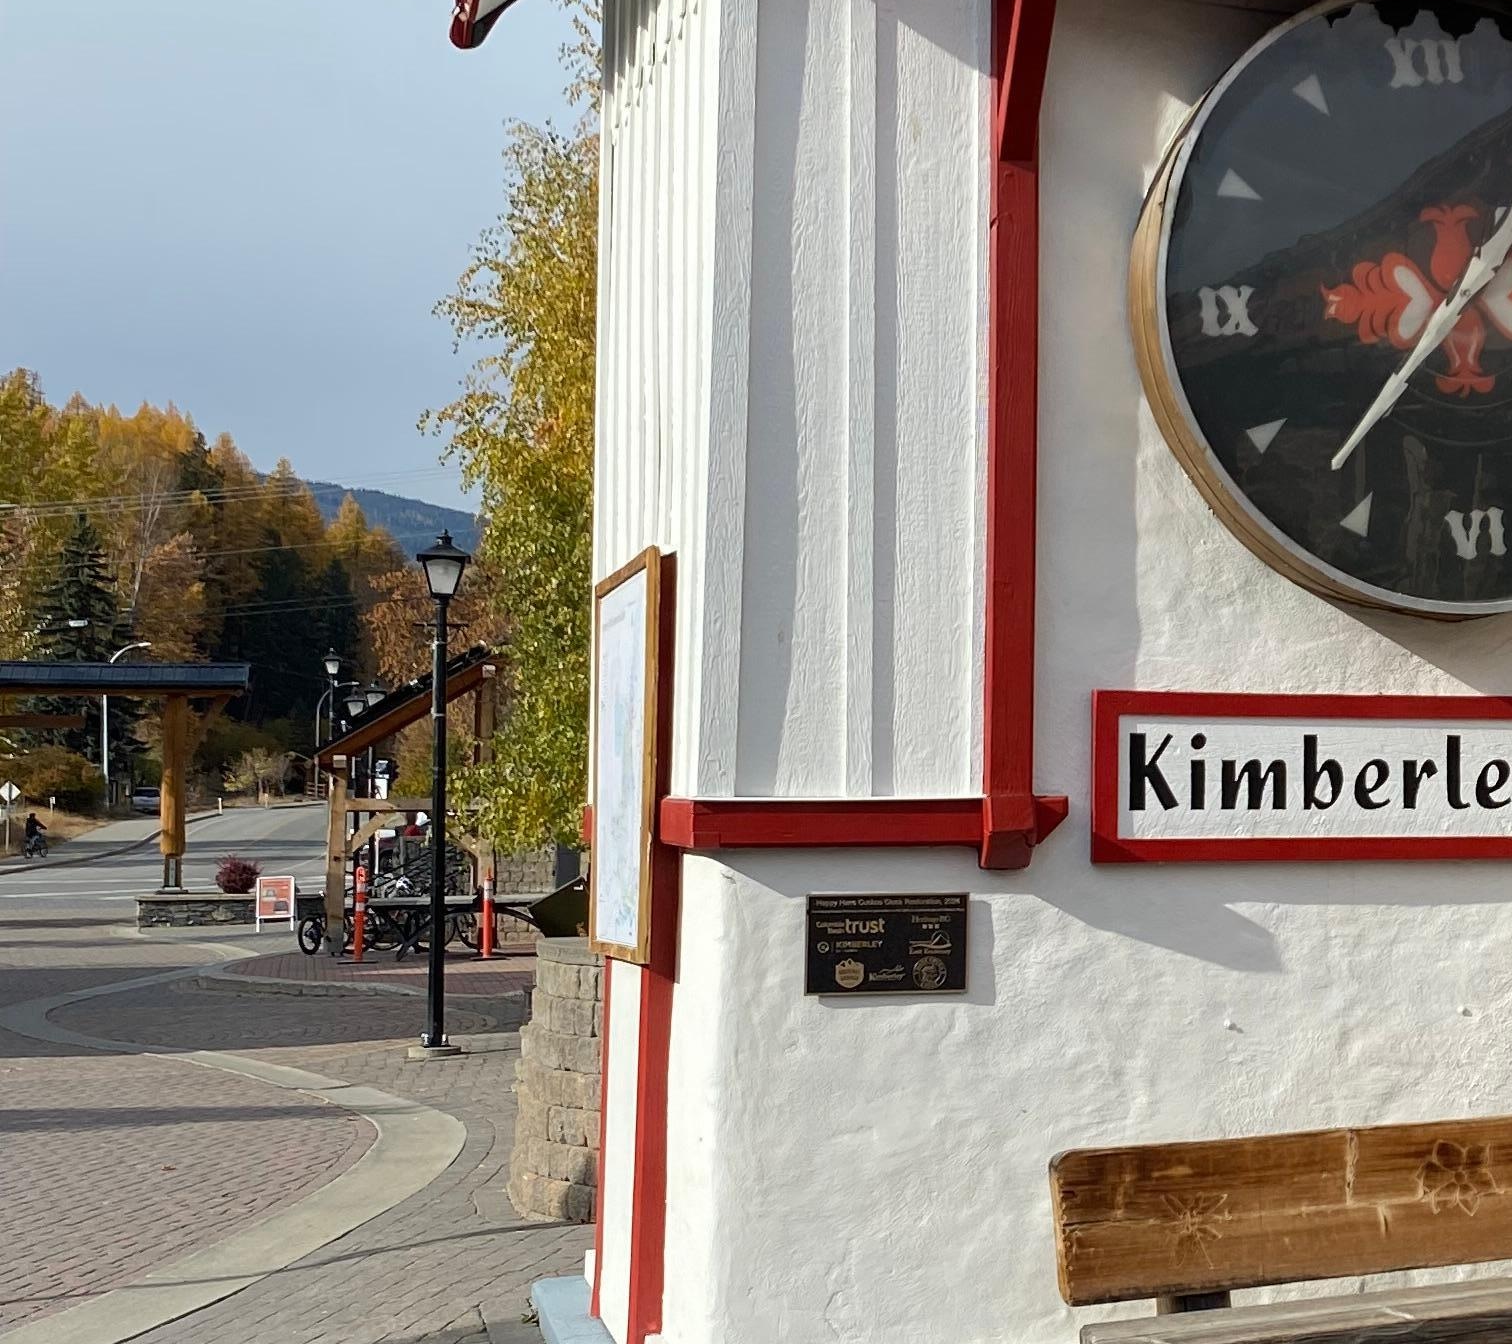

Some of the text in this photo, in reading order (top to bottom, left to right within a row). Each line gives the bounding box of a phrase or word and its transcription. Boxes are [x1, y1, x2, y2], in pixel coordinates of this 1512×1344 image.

[1384, 38, 1464, 90] XII
[1200, 286, 1260, 337] IX
[1444, 506, 1508, 560] VI
[845, 918, 886, 934] trust
